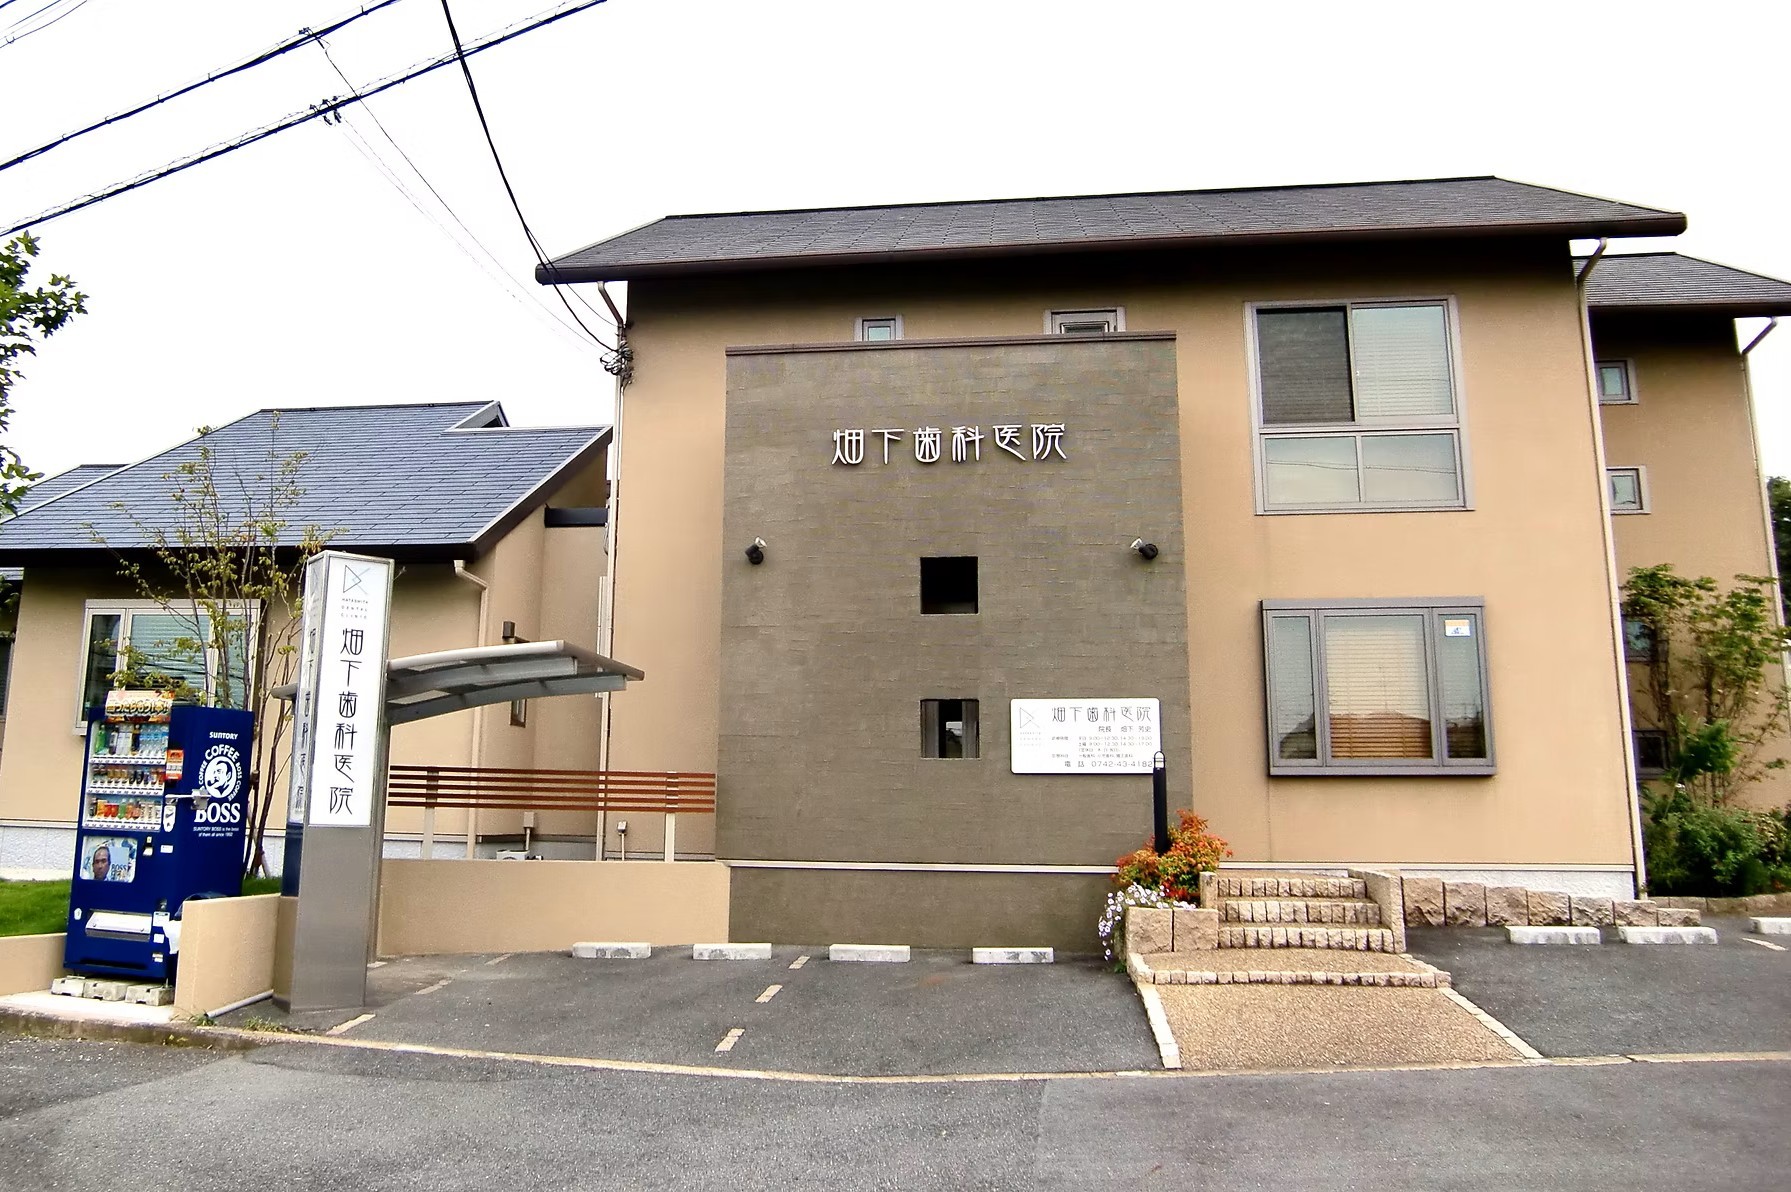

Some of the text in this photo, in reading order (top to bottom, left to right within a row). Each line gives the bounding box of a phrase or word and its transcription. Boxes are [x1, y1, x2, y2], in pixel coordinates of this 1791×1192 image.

[832, 423, 1067, 465] 畑下歯科医院
[330, 629, 364, 814] 畑下歯科医院
[1052, 706, 1151, 722] 畑下歯科医院
[204, 744, 240, 762] COFFEE
